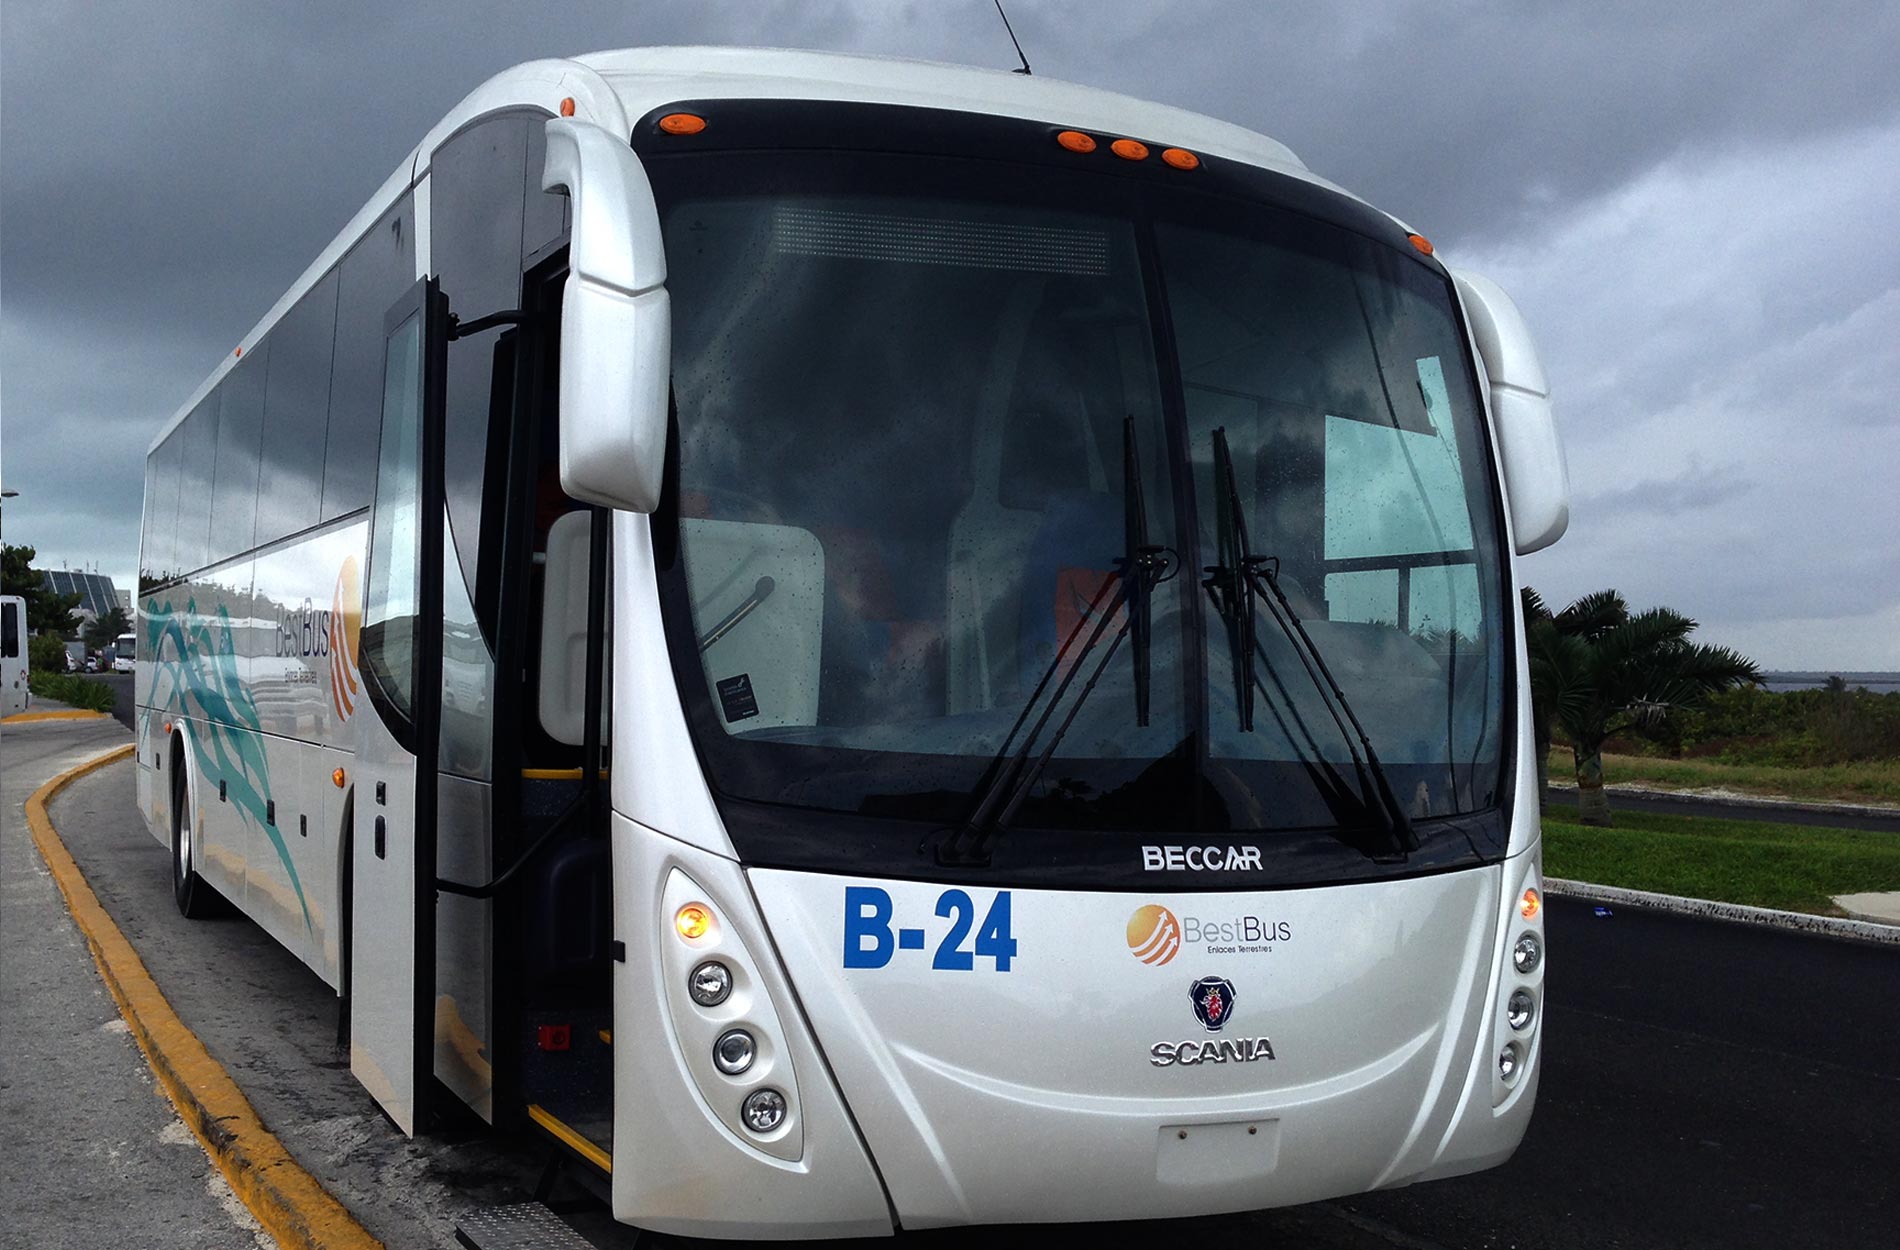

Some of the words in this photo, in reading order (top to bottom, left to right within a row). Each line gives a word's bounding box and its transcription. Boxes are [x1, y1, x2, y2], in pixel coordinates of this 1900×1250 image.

[276, 597, 329, 657] BestBus
[1142, 845, 1263, 871] BECCAR
[844, 886, 1017, 972] B-24
[1184, 916, 1292, 943] BestBus
[1207, 945, 1236, 954] Enlaces
[1238, 944, 1272, 953] Terrestres
[1150, 1037, 1275, 1067] SCANIA
